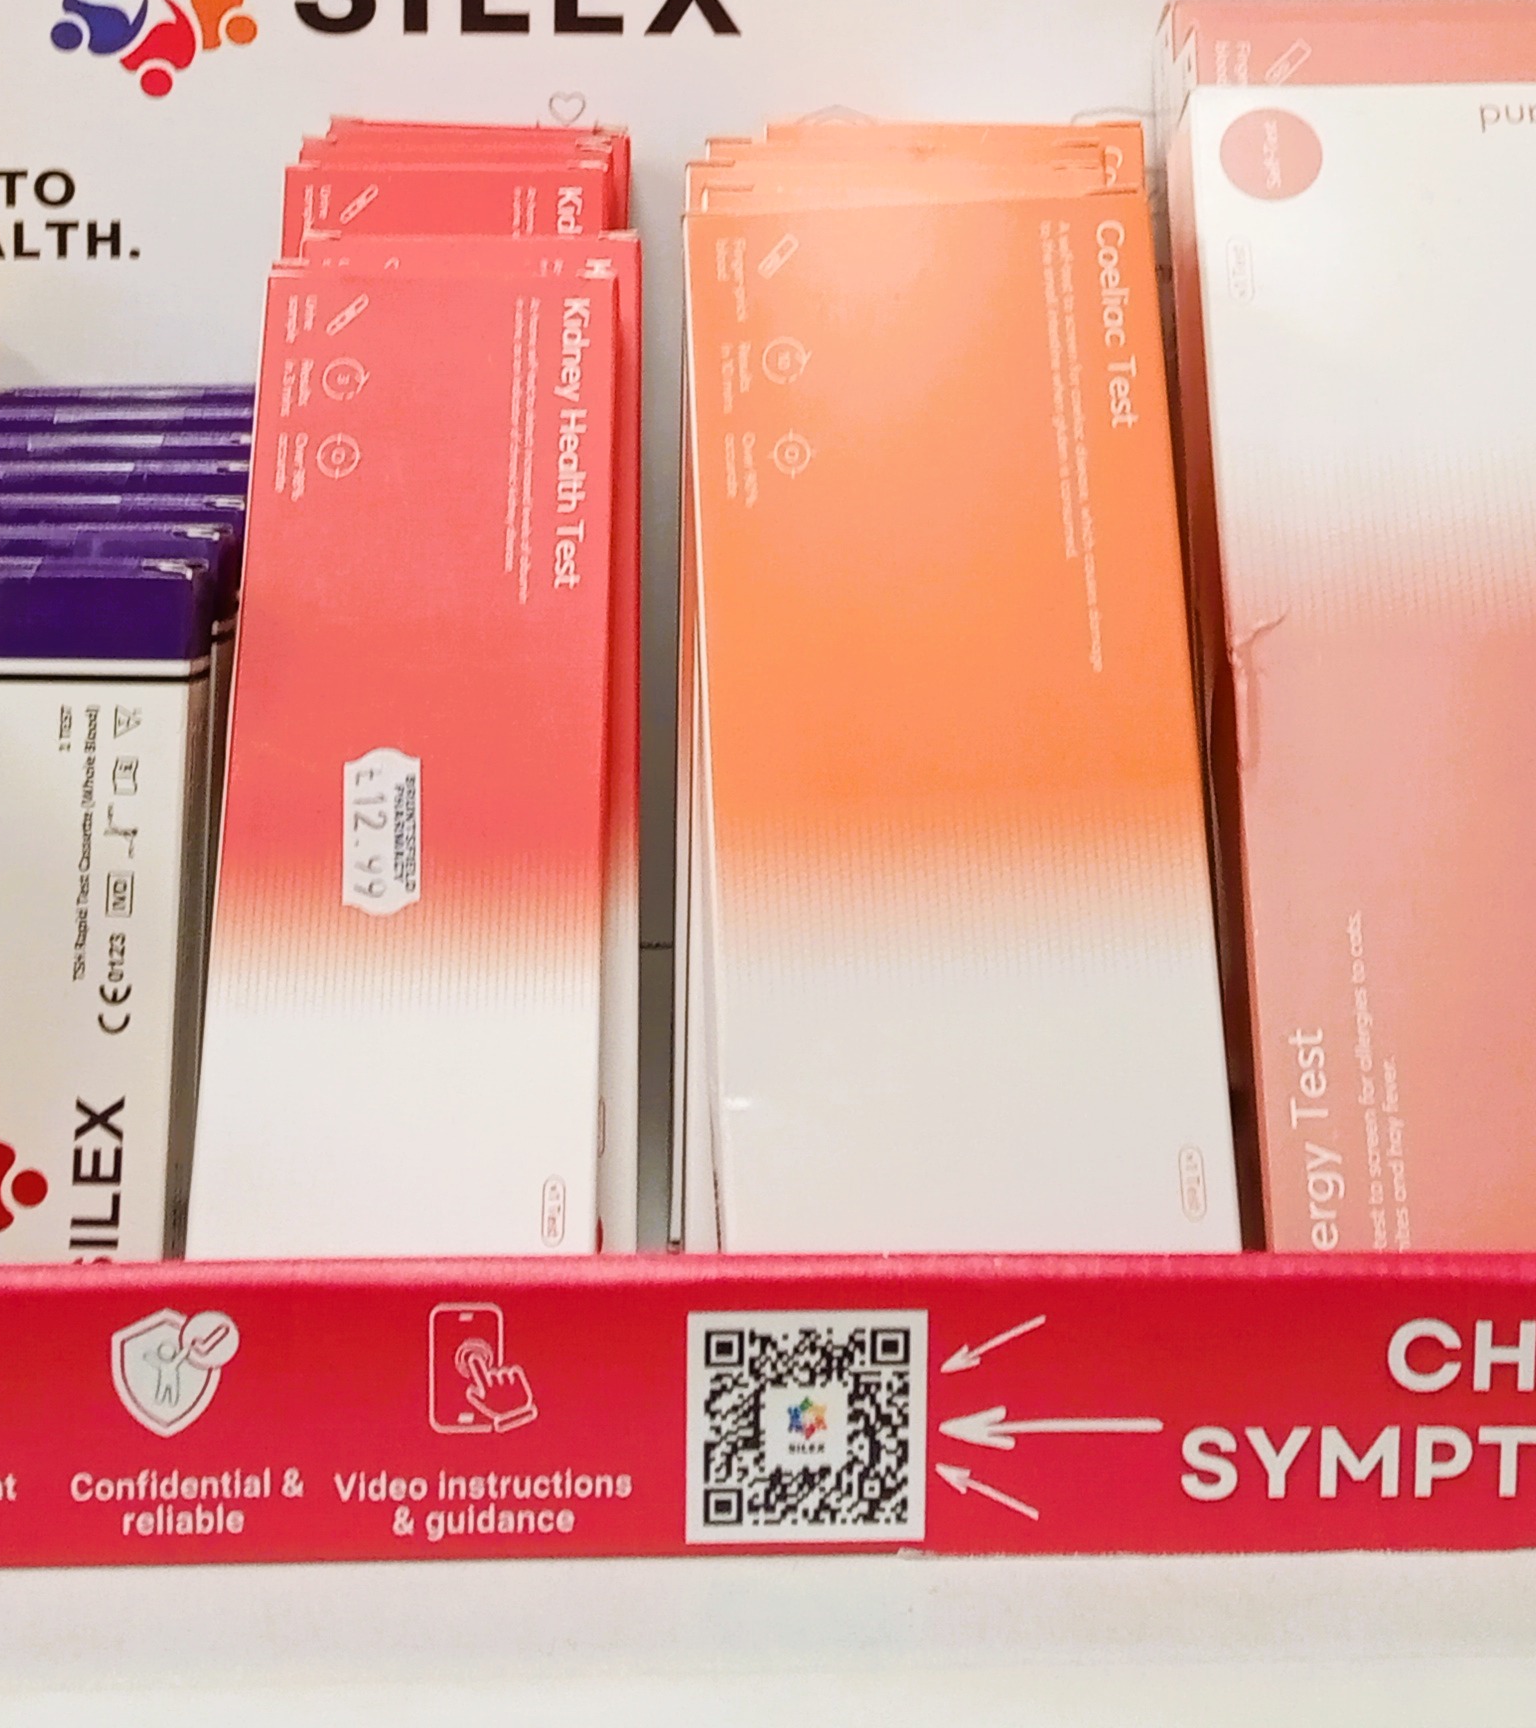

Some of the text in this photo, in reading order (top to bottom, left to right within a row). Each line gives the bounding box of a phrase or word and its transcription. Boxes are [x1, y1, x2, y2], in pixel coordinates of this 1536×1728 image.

[1095, 219, 1139, 429] Coeliac Test
[552, 296, 592, 590] Kidney Health Test
[352, 767, 388, 899] £12.99
[107, 932, 127, 983] 0123
[1288, 1027, 1329, 1130] Test
[69, 1469, 304, 1502] Confidential &
[333, 1470, 633, 1502] Video instructions
[120, 1503, 247, 1537] reliable
[392, 1503, 576, 1539] & guidance
